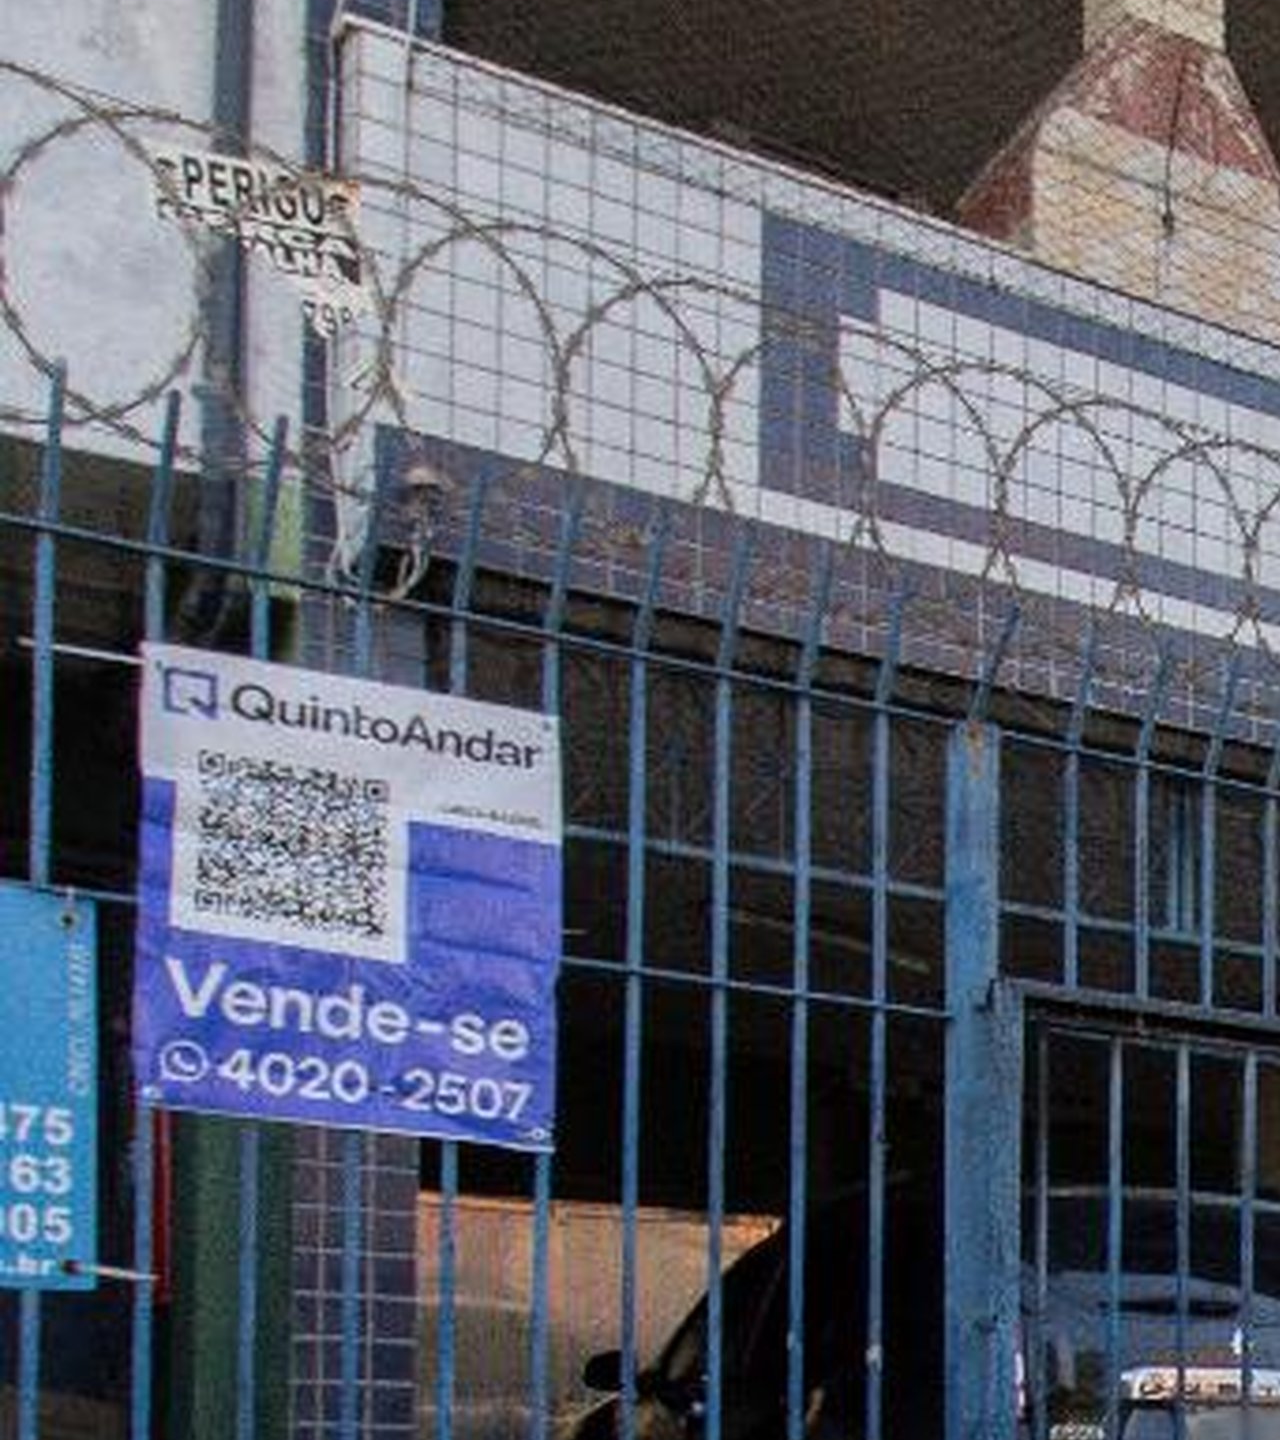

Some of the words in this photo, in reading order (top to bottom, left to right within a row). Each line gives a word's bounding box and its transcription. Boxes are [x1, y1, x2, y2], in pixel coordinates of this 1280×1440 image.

[231, 683, 541, 769] QuintoAndar
[165, 956, 530, 1059] Vende-se
[0, 1105, 73, 1146] 75
[0, 1202, 72, 1243] 05
